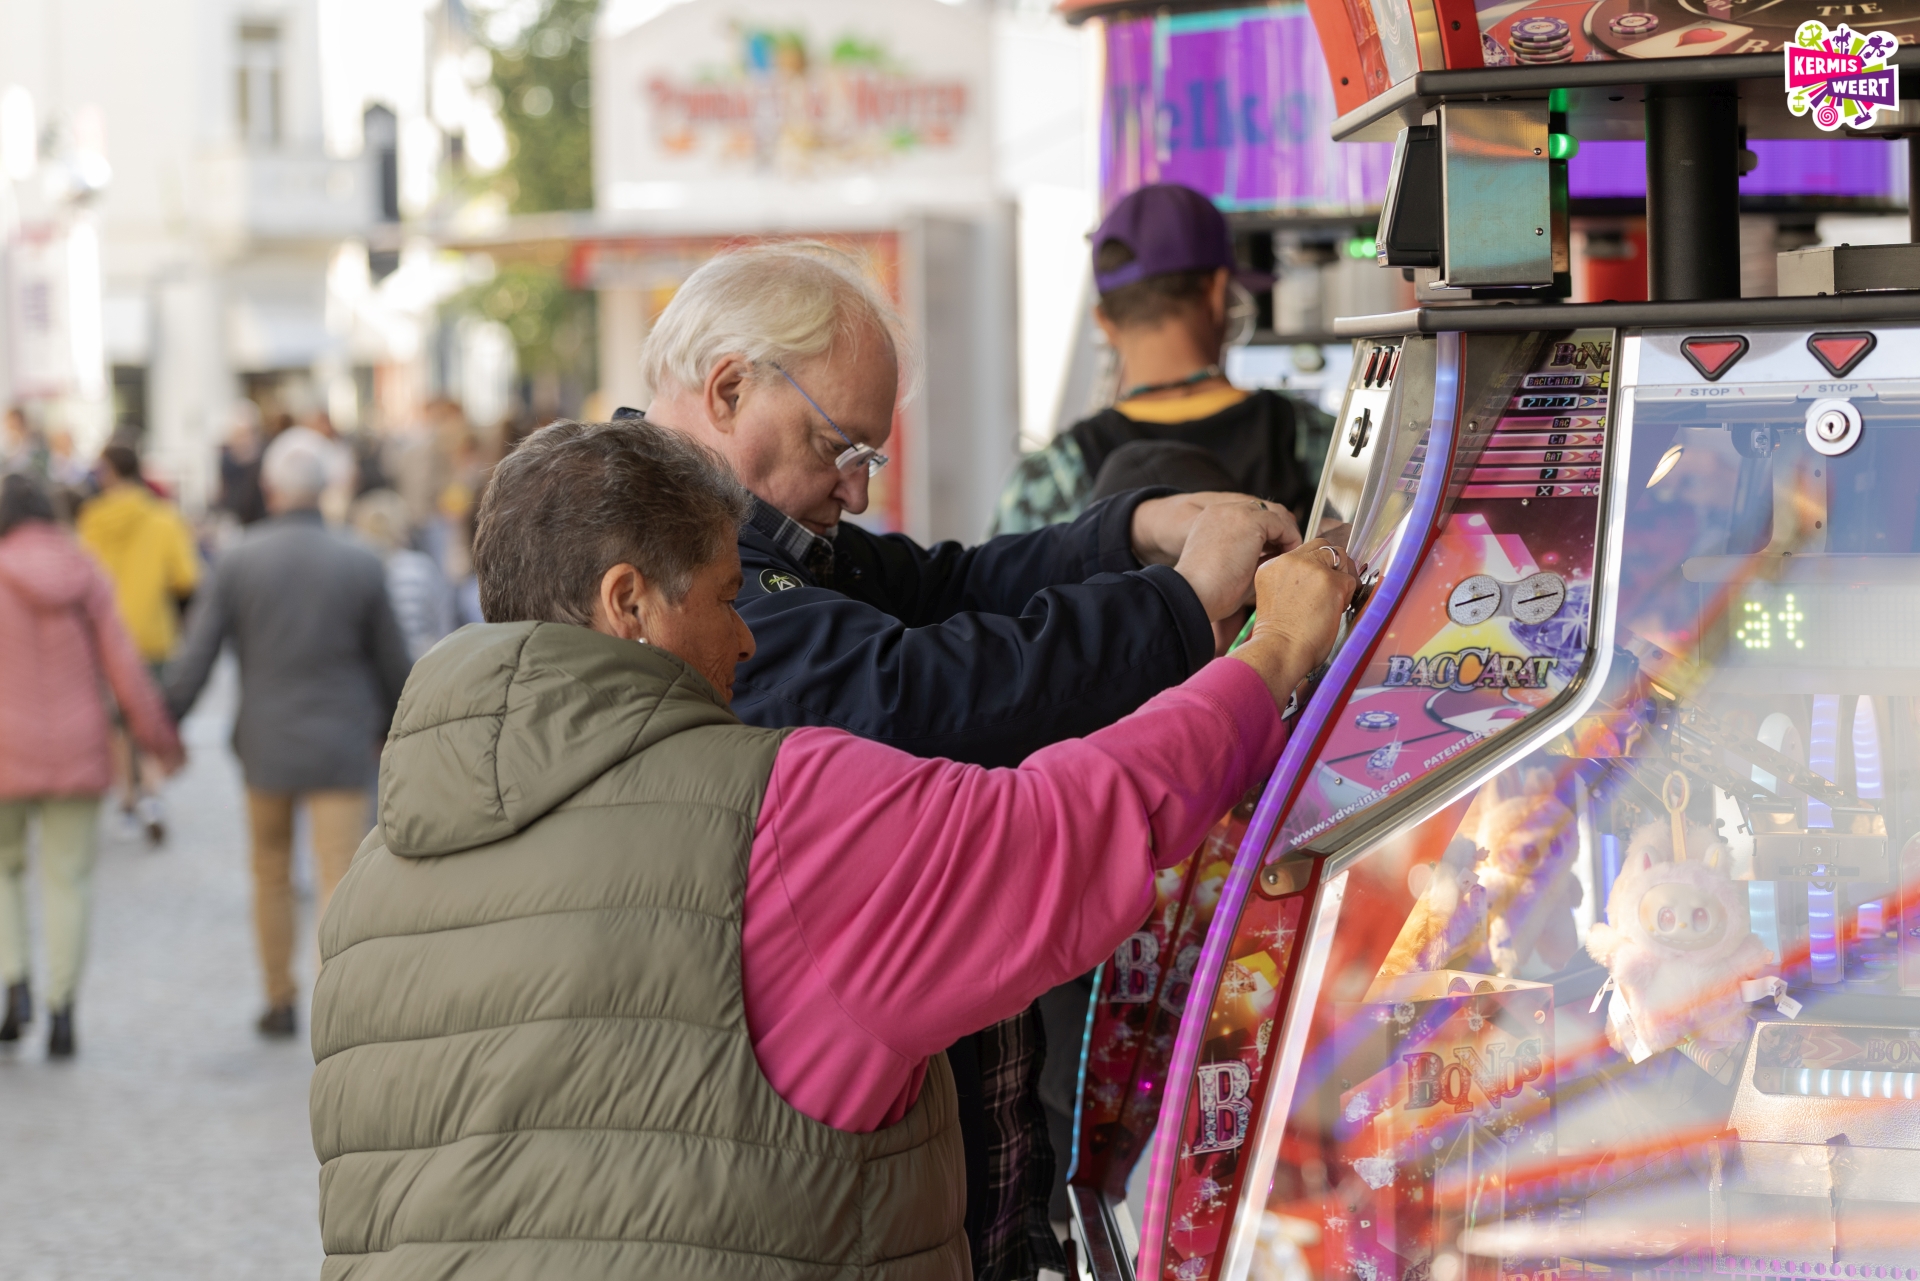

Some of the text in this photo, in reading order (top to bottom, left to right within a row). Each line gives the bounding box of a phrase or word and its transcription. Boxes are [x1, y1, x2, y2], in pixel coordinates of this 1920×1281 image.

[1817, 2, 1883, 17] TIE
[1690, 387, 1730, 397] STOP
[1818, 383, 1859, 393] STOP
[1382, 646, 1558, 693] BACCARAT
[1423, 730, 1482, 769] PATENTED
[1289, 771, 1411, 847] www.vdw-int.com
[1403, 1038, 1543, 1113] BONUS
